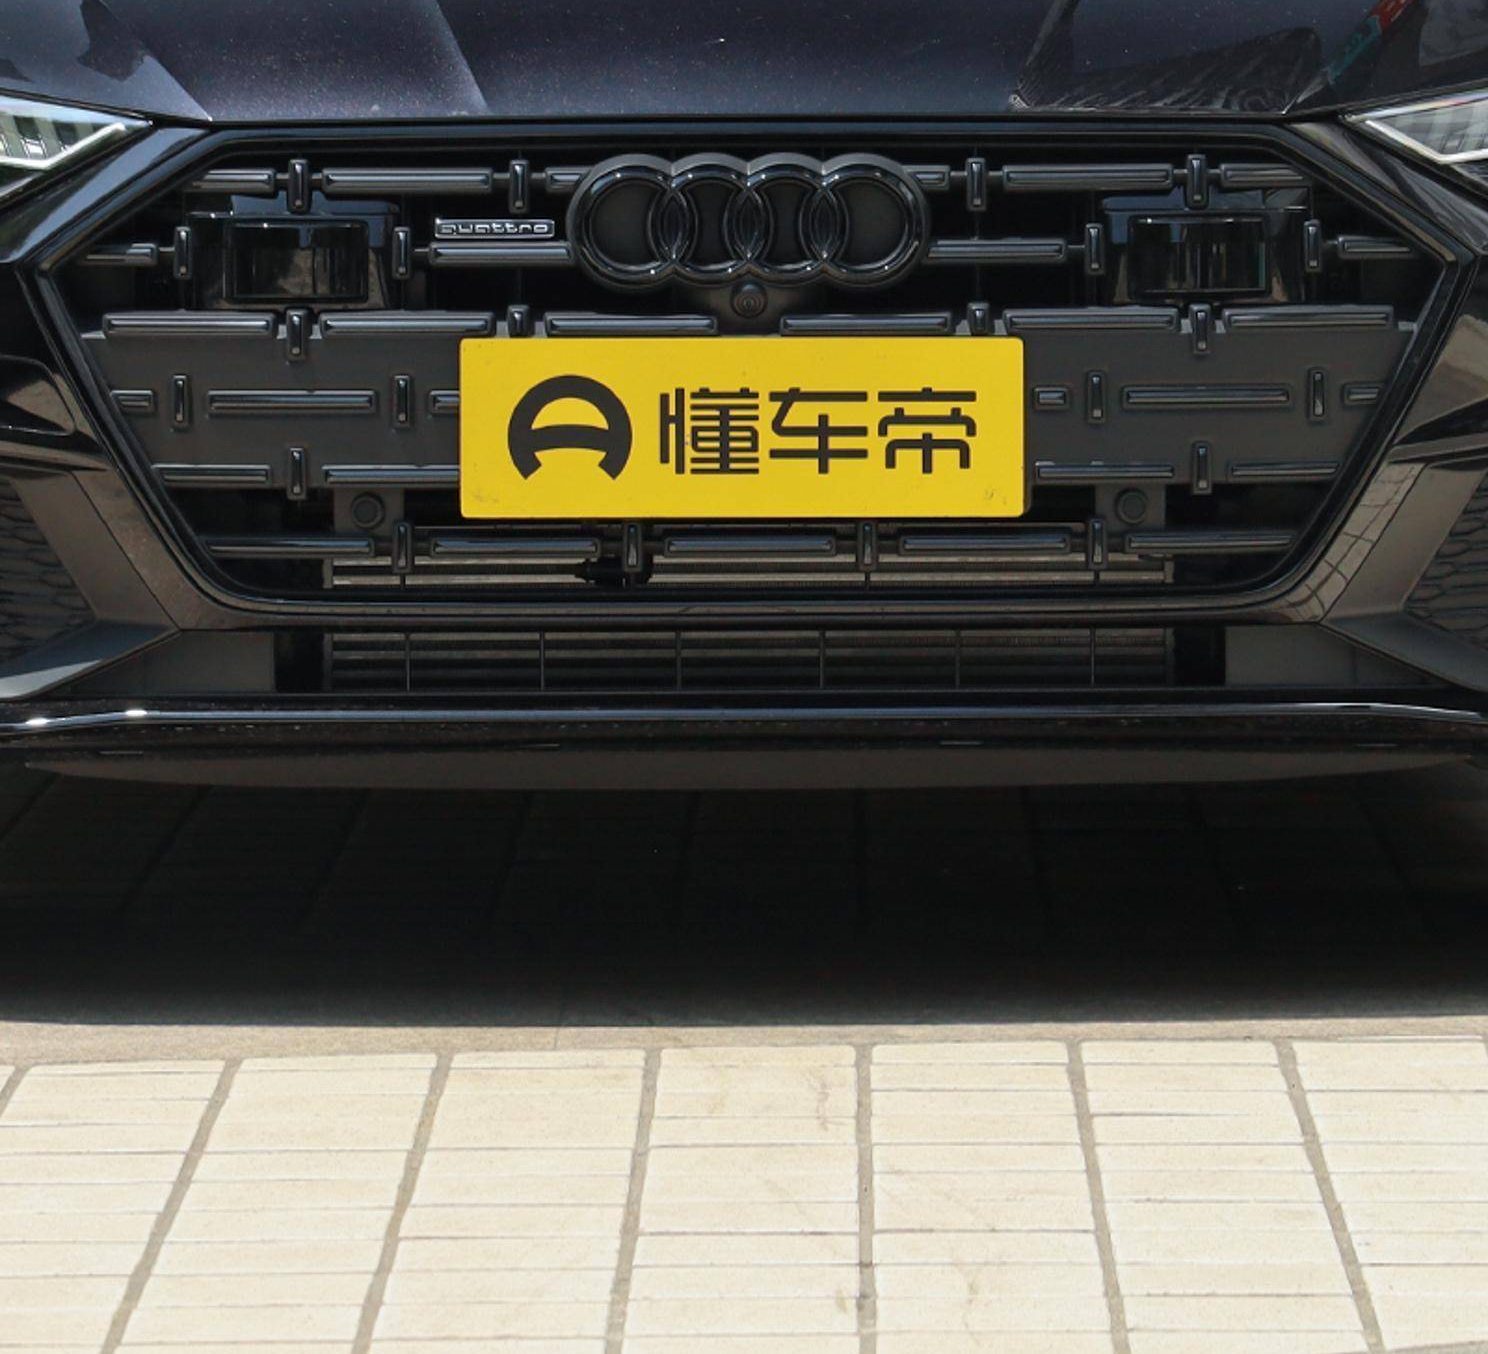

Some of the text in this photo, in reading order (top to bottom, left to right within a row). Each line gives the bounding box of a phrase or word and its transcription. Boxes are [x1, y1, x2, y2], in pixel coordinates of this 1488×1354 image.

[439, 222, 549, 236] quattro
[659, 386, 977, 475] 懂车帝
